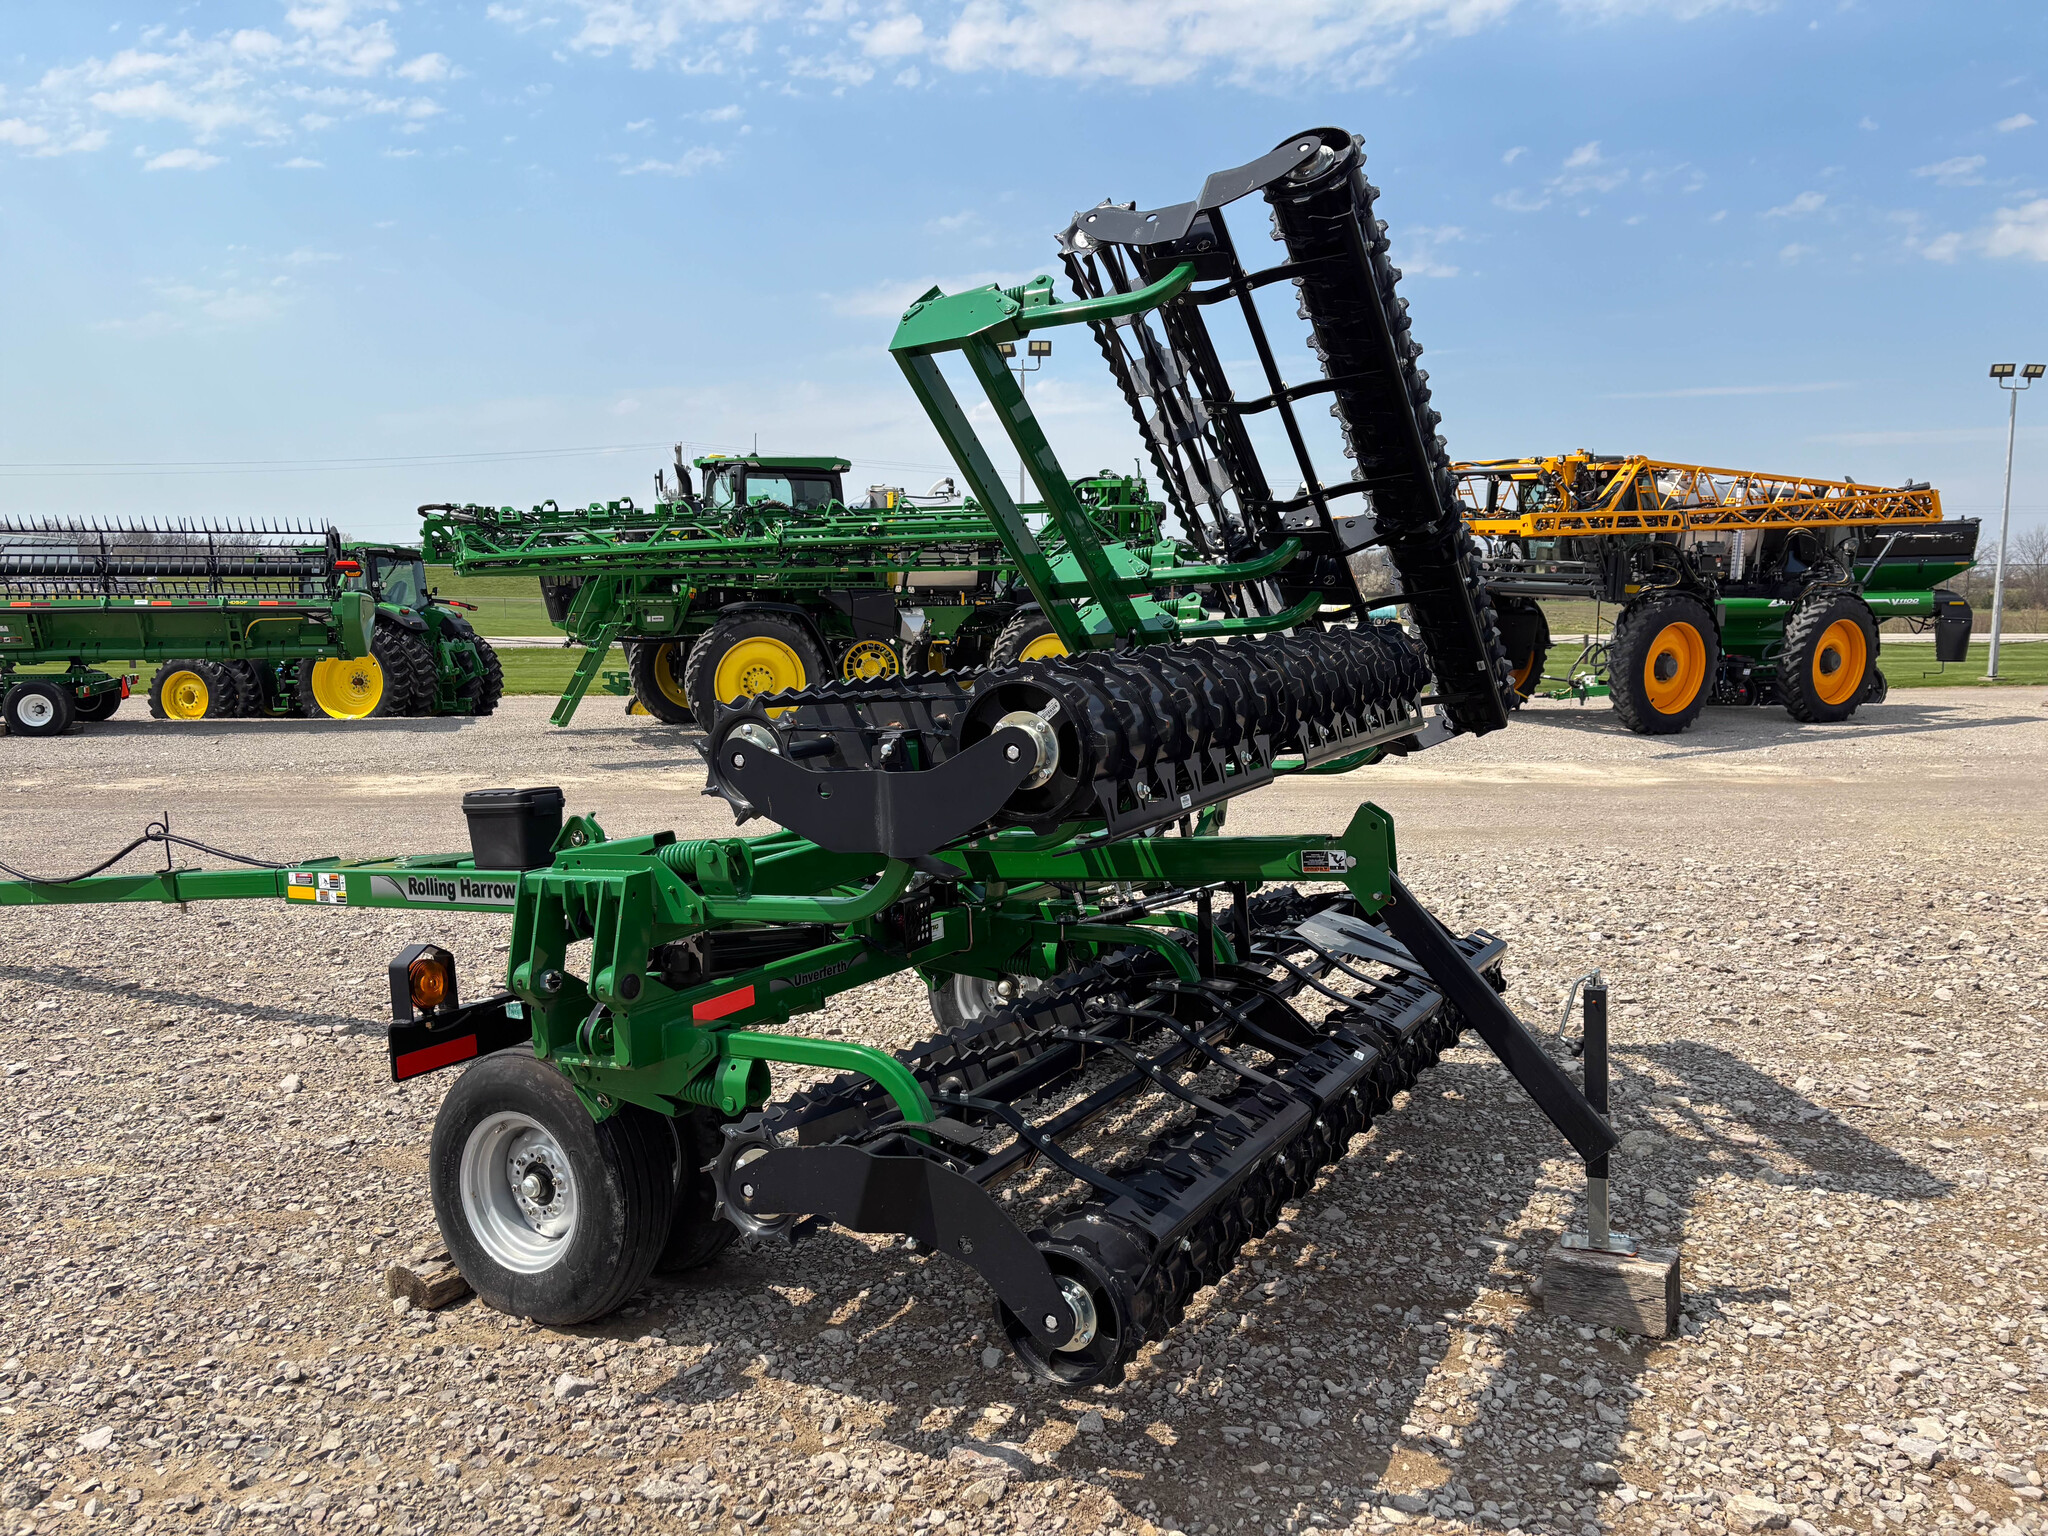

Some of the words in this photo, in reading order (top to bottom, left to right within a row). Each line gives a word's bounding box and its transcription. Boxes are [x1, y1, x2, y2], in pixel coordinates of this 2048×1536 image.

[408, 877, 456, 901] Rolling
[460, 878, 516, 899] Harrow
[794, 960, 847, 986] Unverferth
